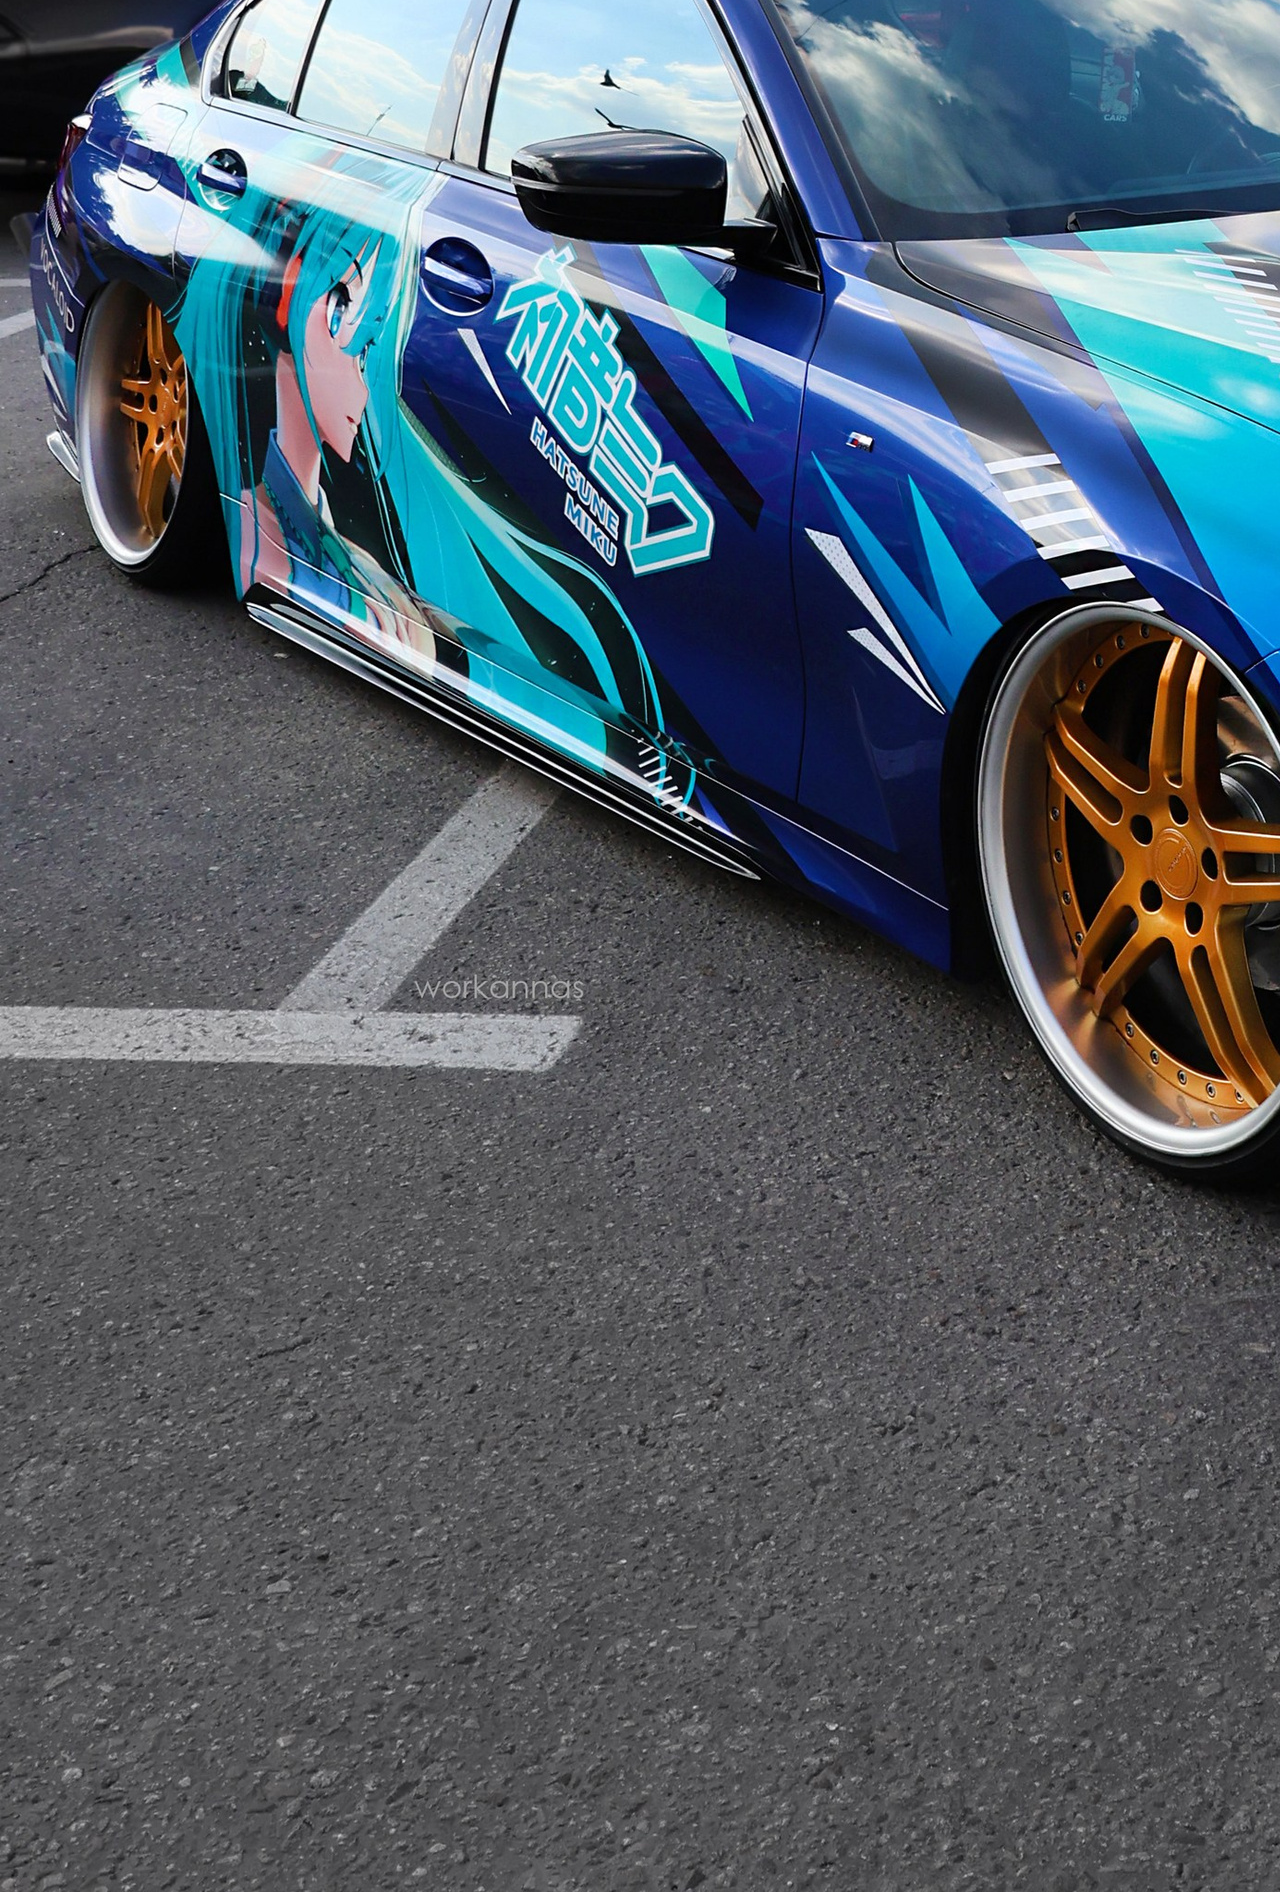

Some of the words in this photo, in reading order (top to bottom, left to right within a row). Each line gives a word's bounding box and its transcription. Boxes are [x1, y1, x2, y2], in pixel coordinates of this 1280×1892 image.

[40, 237, 76, 333] VOCALOID
[530, 416, 620, 540] HATSUNE
[563, 492, 618, 567] MIKU
